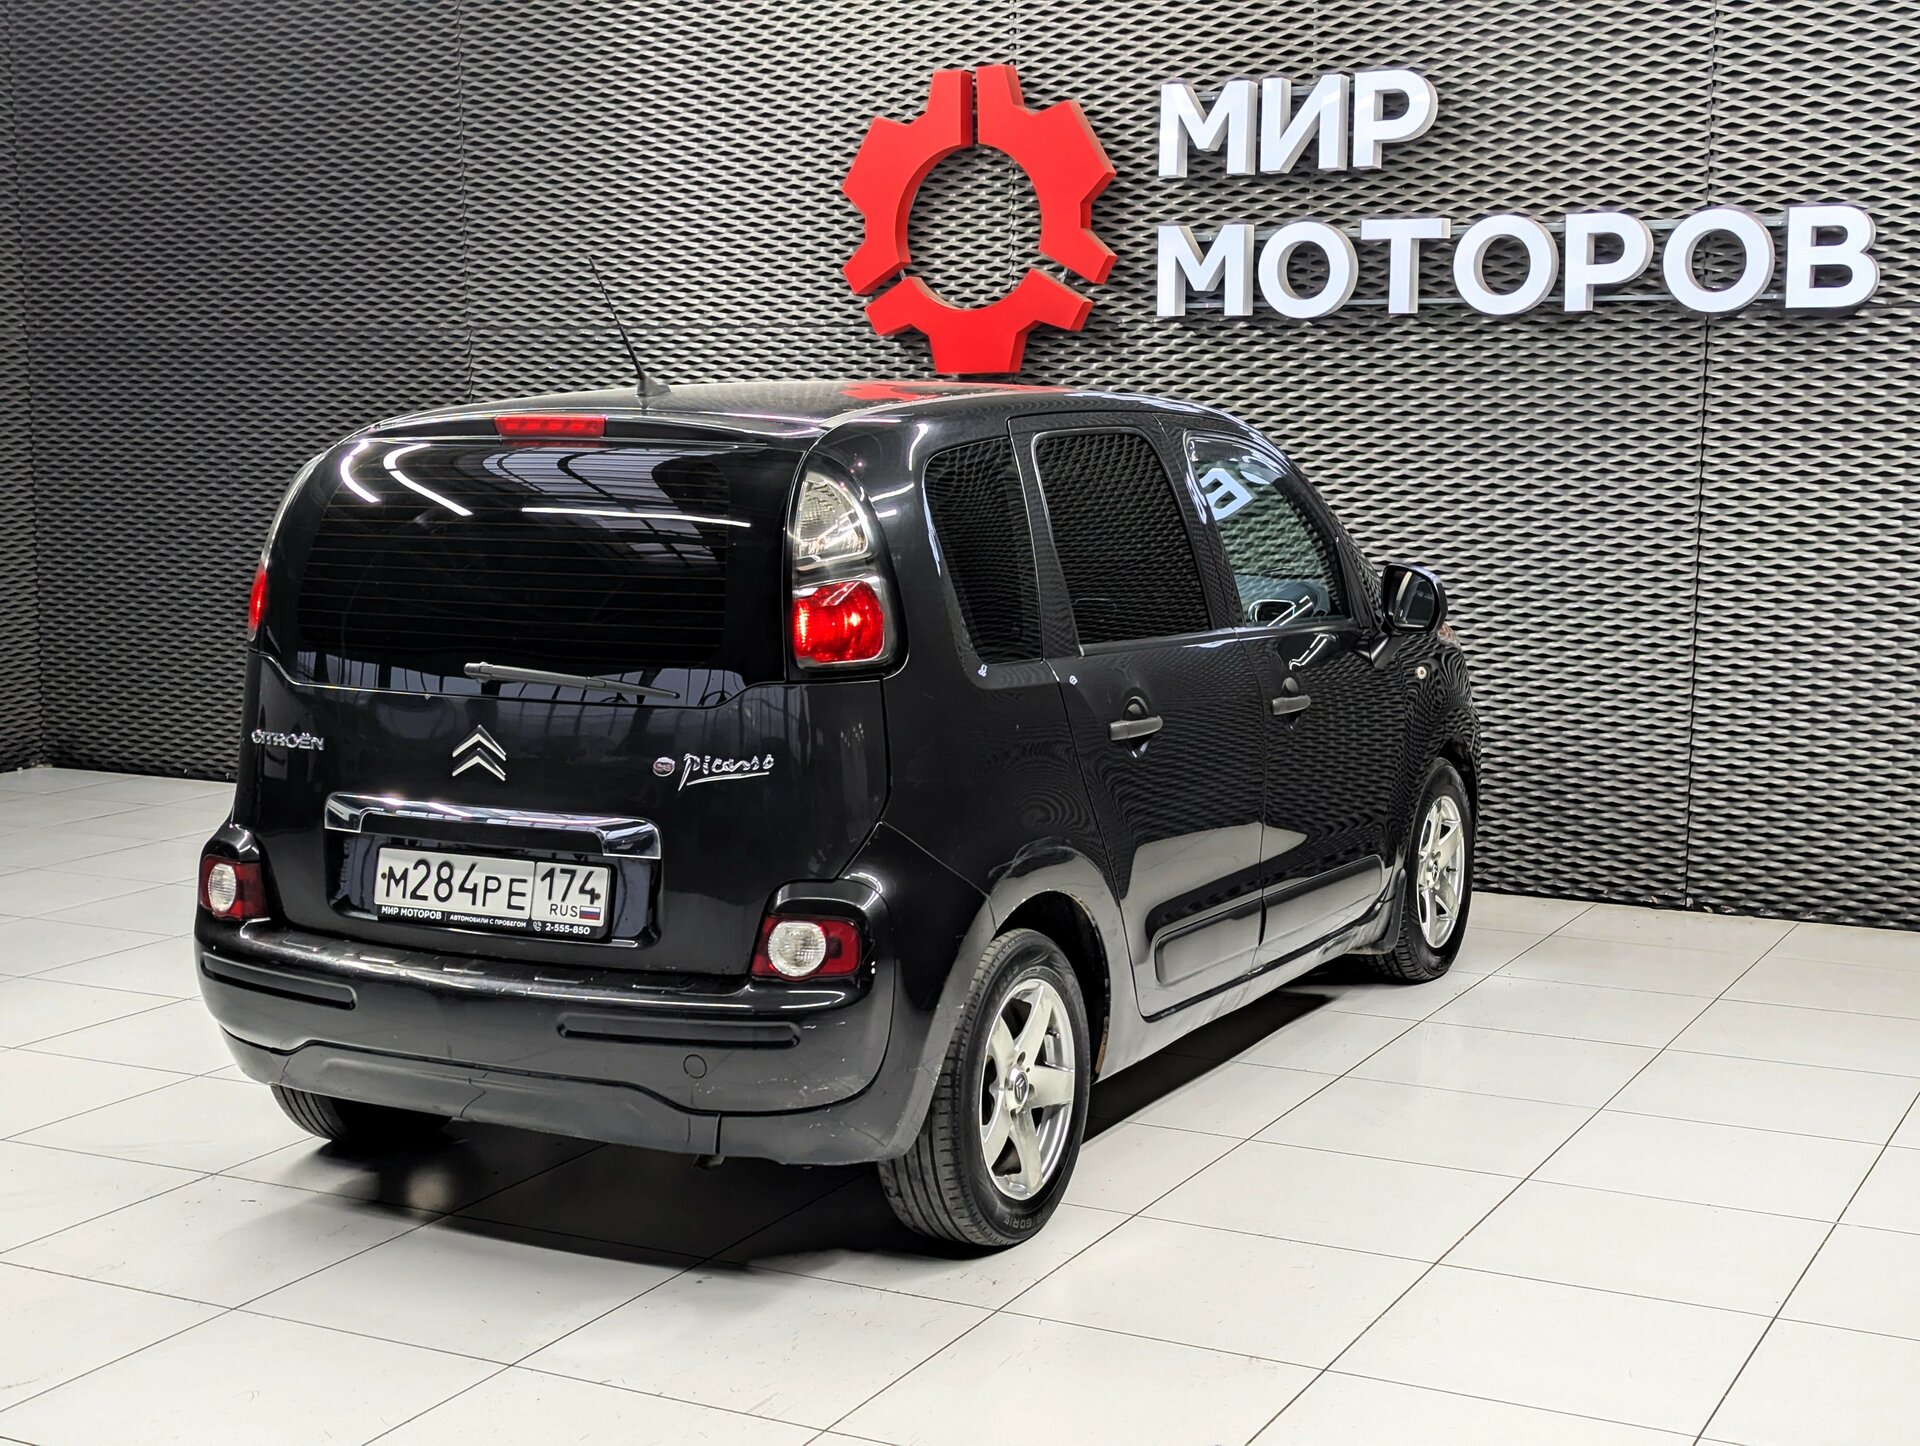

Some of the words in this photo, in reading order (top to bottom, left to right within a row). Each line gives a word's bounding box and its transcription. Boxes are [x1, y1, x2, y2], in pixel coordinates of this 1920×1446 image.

[1158, 69, 1439, 178] МИР
[1156, 205, 1881, 318] МОТОРОВ
[385, 859, 528, 911] М284РЕ
[541, 867, 596, 905] 174
[549, 903, 578, 918] RUS
[381, 906, 399, 915] МИР
[400, 909, 442, 920] МОТОРОВ
[450, 914, 488, 925] АВТОМОБИЛИ
[494, 919, 527, 928] ПРОБЕГОМ
[545, 923, 591, 935] 2-555-850
